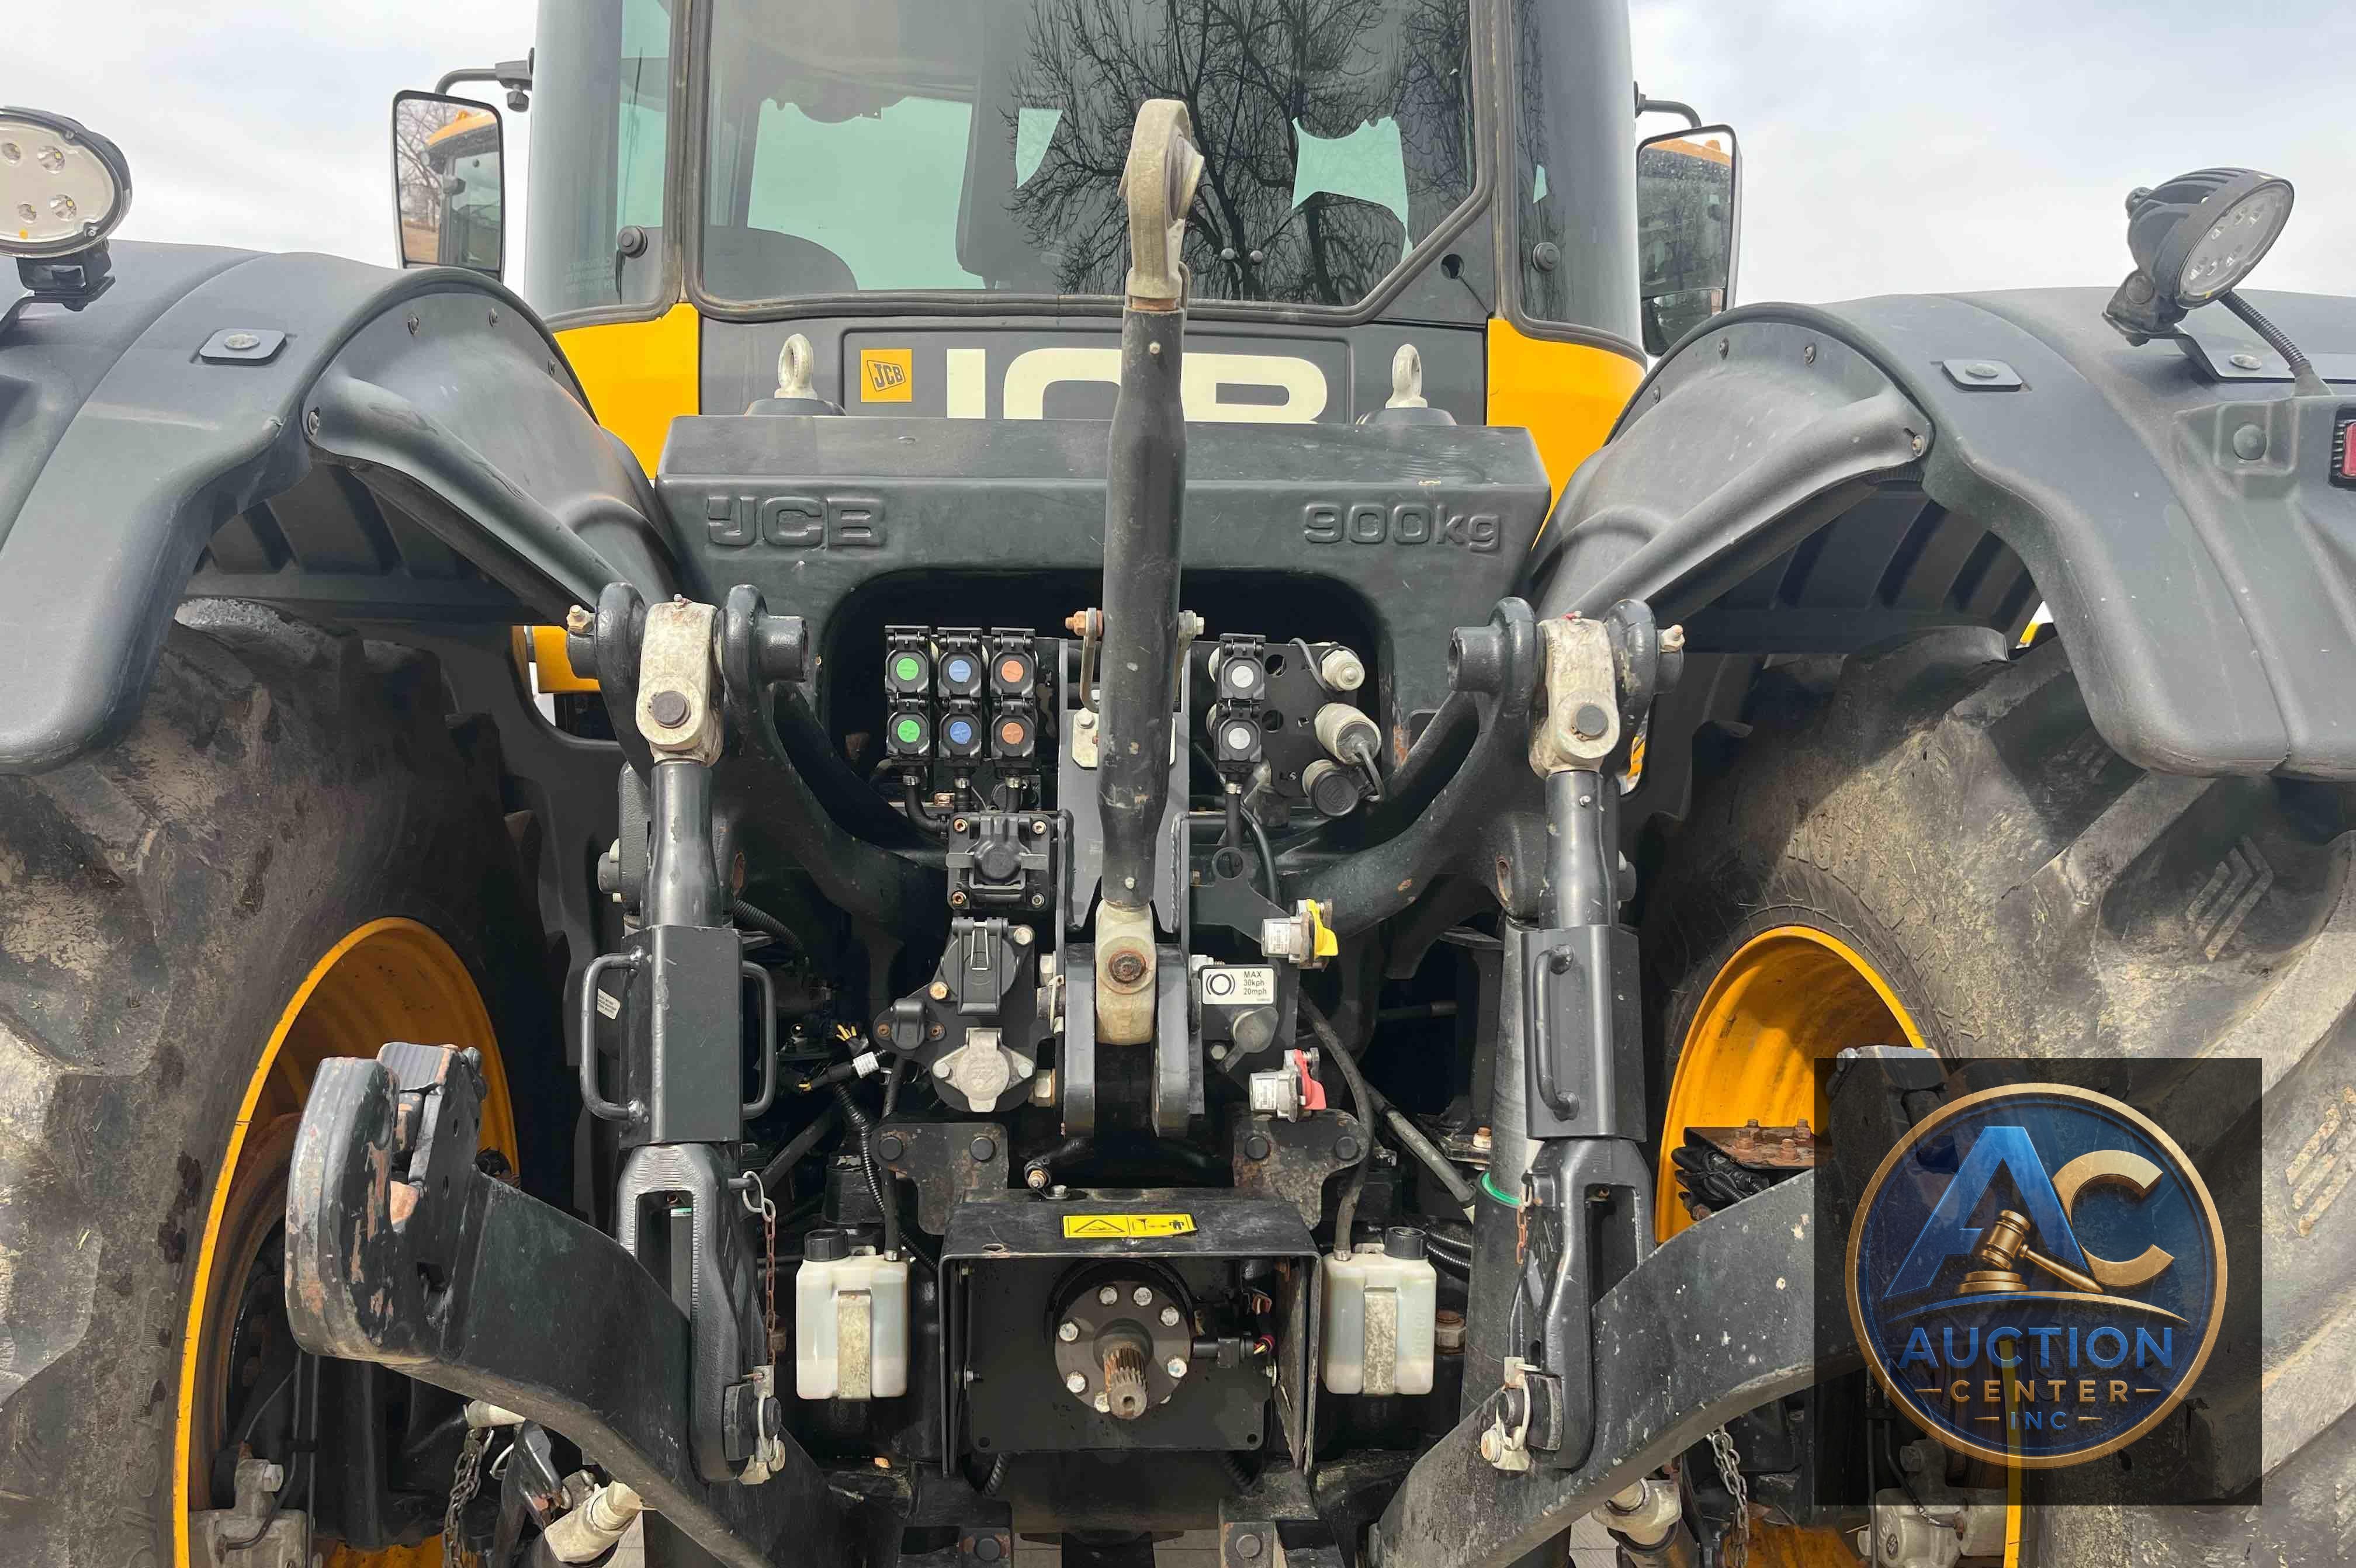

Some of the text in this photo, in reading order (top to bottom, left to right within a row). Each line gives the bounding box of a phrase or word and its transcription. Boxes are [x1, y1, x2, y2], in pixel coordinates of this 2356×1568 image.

[874, 363, 903, 388] JCB
[707, 495, 886, 548] JCB
[1303, 502, 1501, 553] 900kg
[1243, 979, 1265, 987] 30kph
